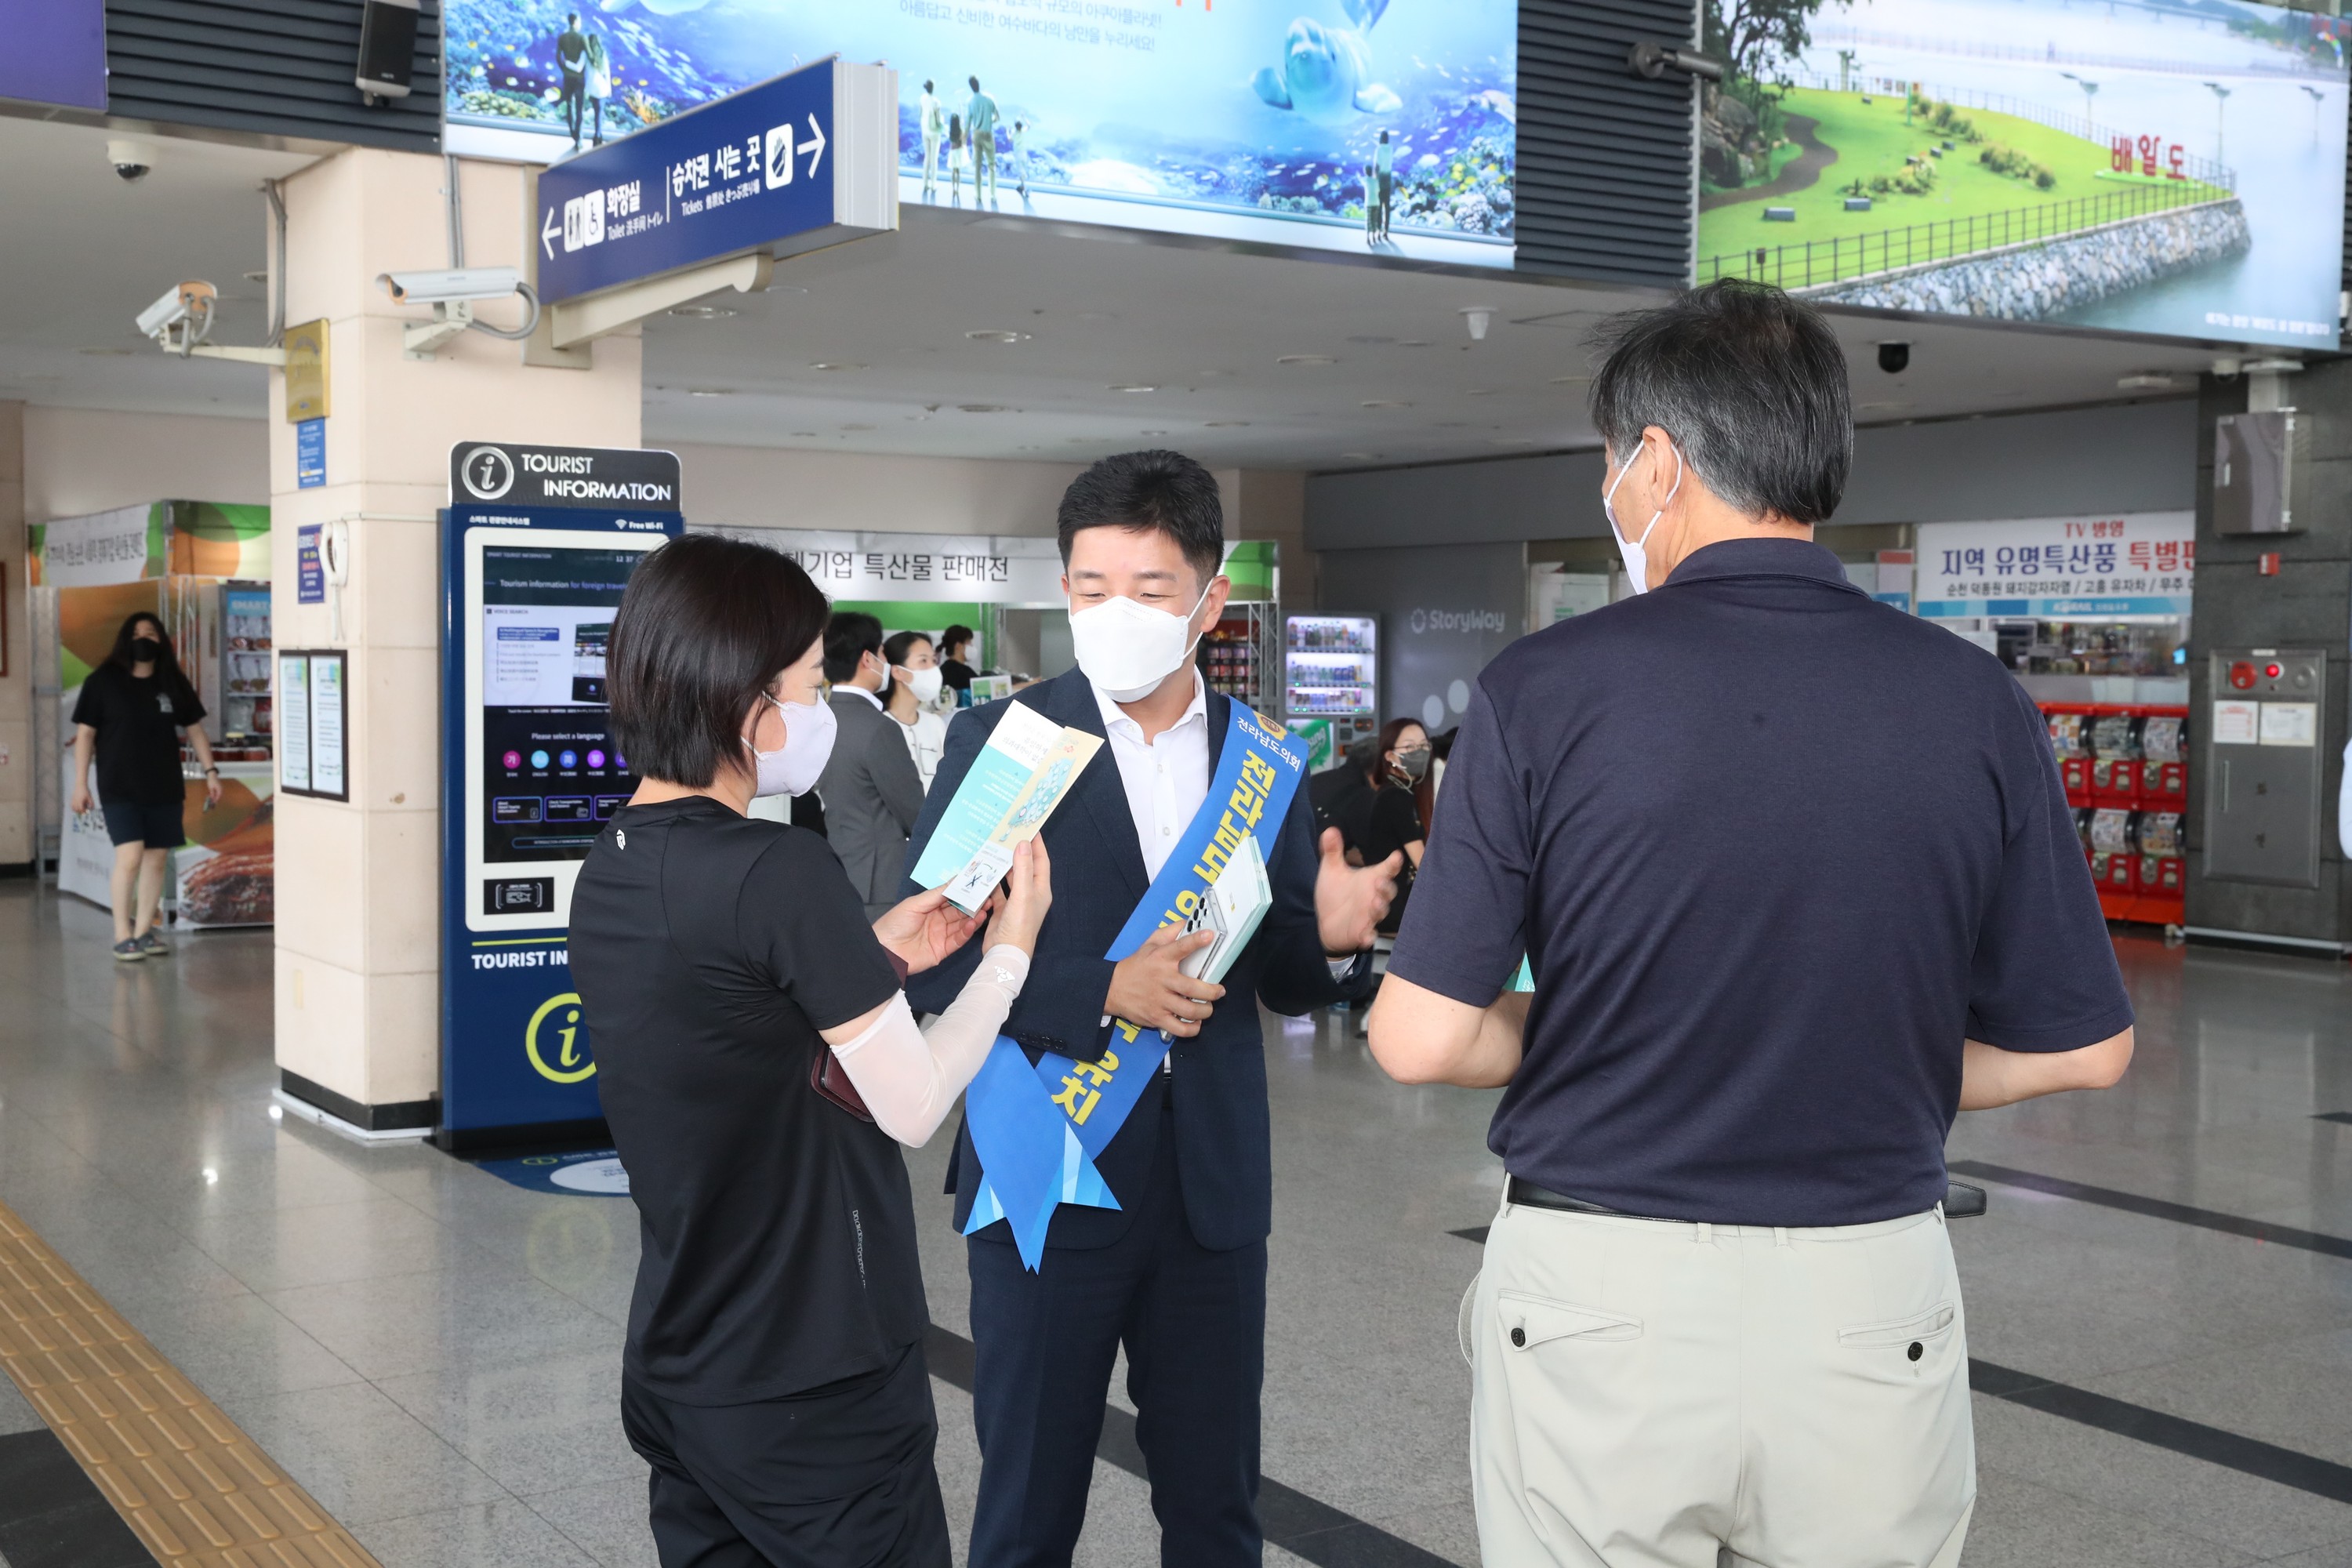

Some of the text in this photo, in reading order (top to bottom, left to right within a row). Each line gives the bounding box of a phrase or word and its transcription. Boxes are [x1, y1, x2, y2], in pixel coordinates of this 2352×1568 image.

[899, 0, 1156, 53] 아름답고 신비한 여수바다의 낭만을 누리세요!
[672, 134, 760, 198] 승차권 사는 곳
[607, 180, 641, 217] 화장실
[681, 198, 703, 216] Tickets
[607, 221, 626, 241] Toilet
[648, 209, 663, 231] トイレ
[521, 454, 593, 474] TOURIST
[543, 479, 671, 501] INFORMATION
[645, 521, 664, 530] Wi-Fi
[2064, 520, 2125, 539] TV 방영
[863, 553, 933, 581] 특산물
[942, 556, 1008, 583] 판매전
[1940, 548, 1984, 576] 지역
[499, 579, 528, 588] Tourism
[529, 580, 569, 589] information
[582, 582, 605, 590] foreign
[1236, 717, 1301, 772] 전라남도의회
[471, 951, 546, 970] TOURIST
[1051, 1050, 1120, 1126] 유치
